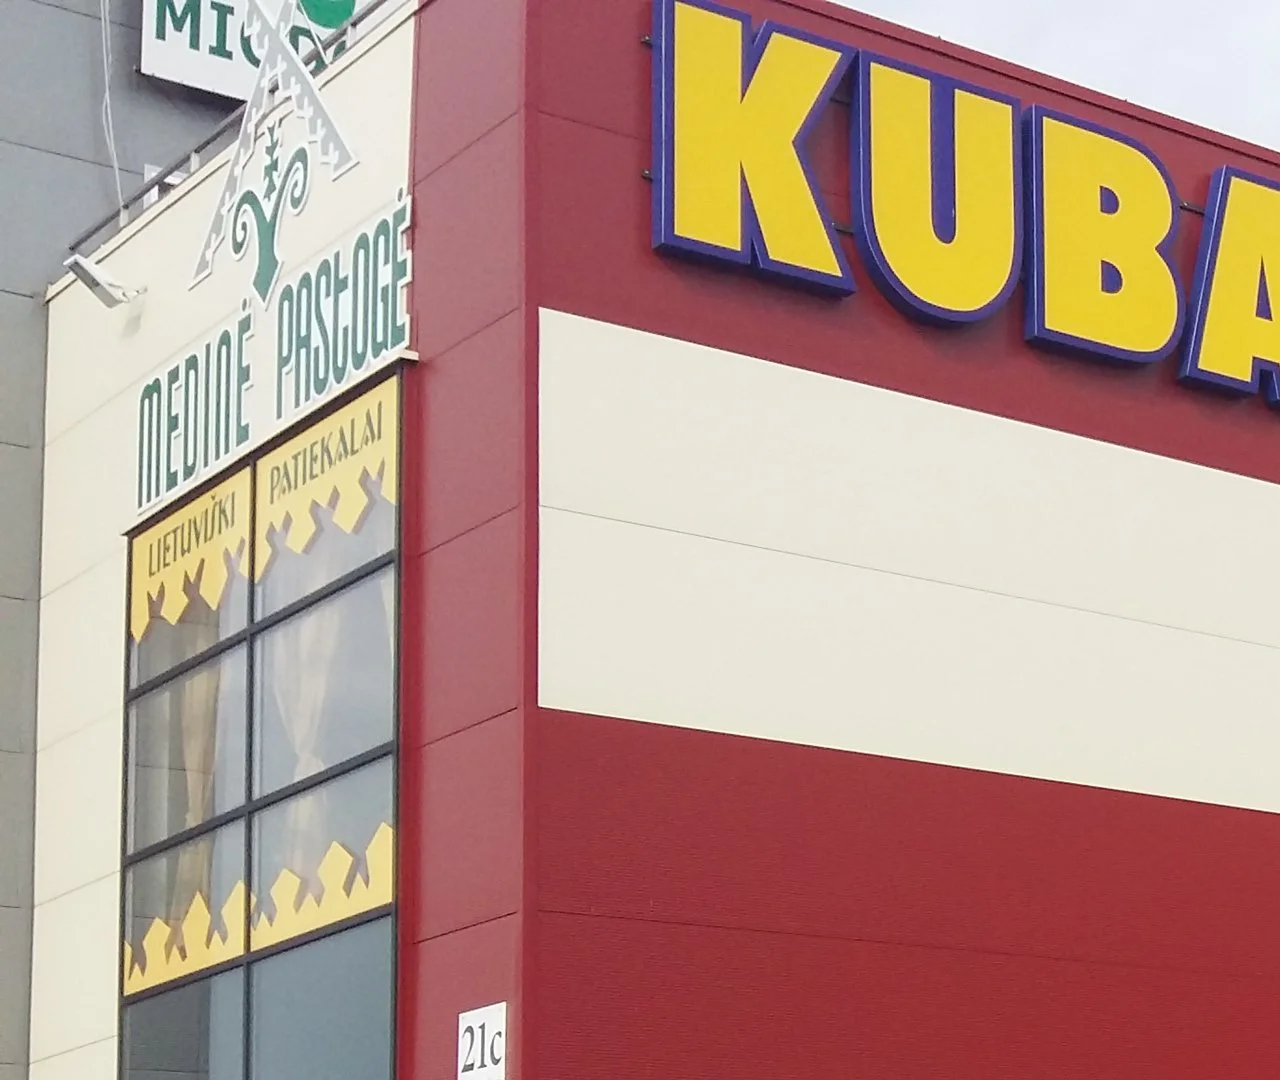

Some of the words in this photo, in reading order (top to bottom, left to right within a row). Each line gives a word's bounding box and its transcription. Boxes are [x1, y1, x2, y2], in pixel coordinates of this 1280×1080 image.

[147, 491, 236, 576] LIETUVIŠKI
[269, 401, 383, 504] PATIEKALAI
[461, 1021, 502, 1073] 21c
